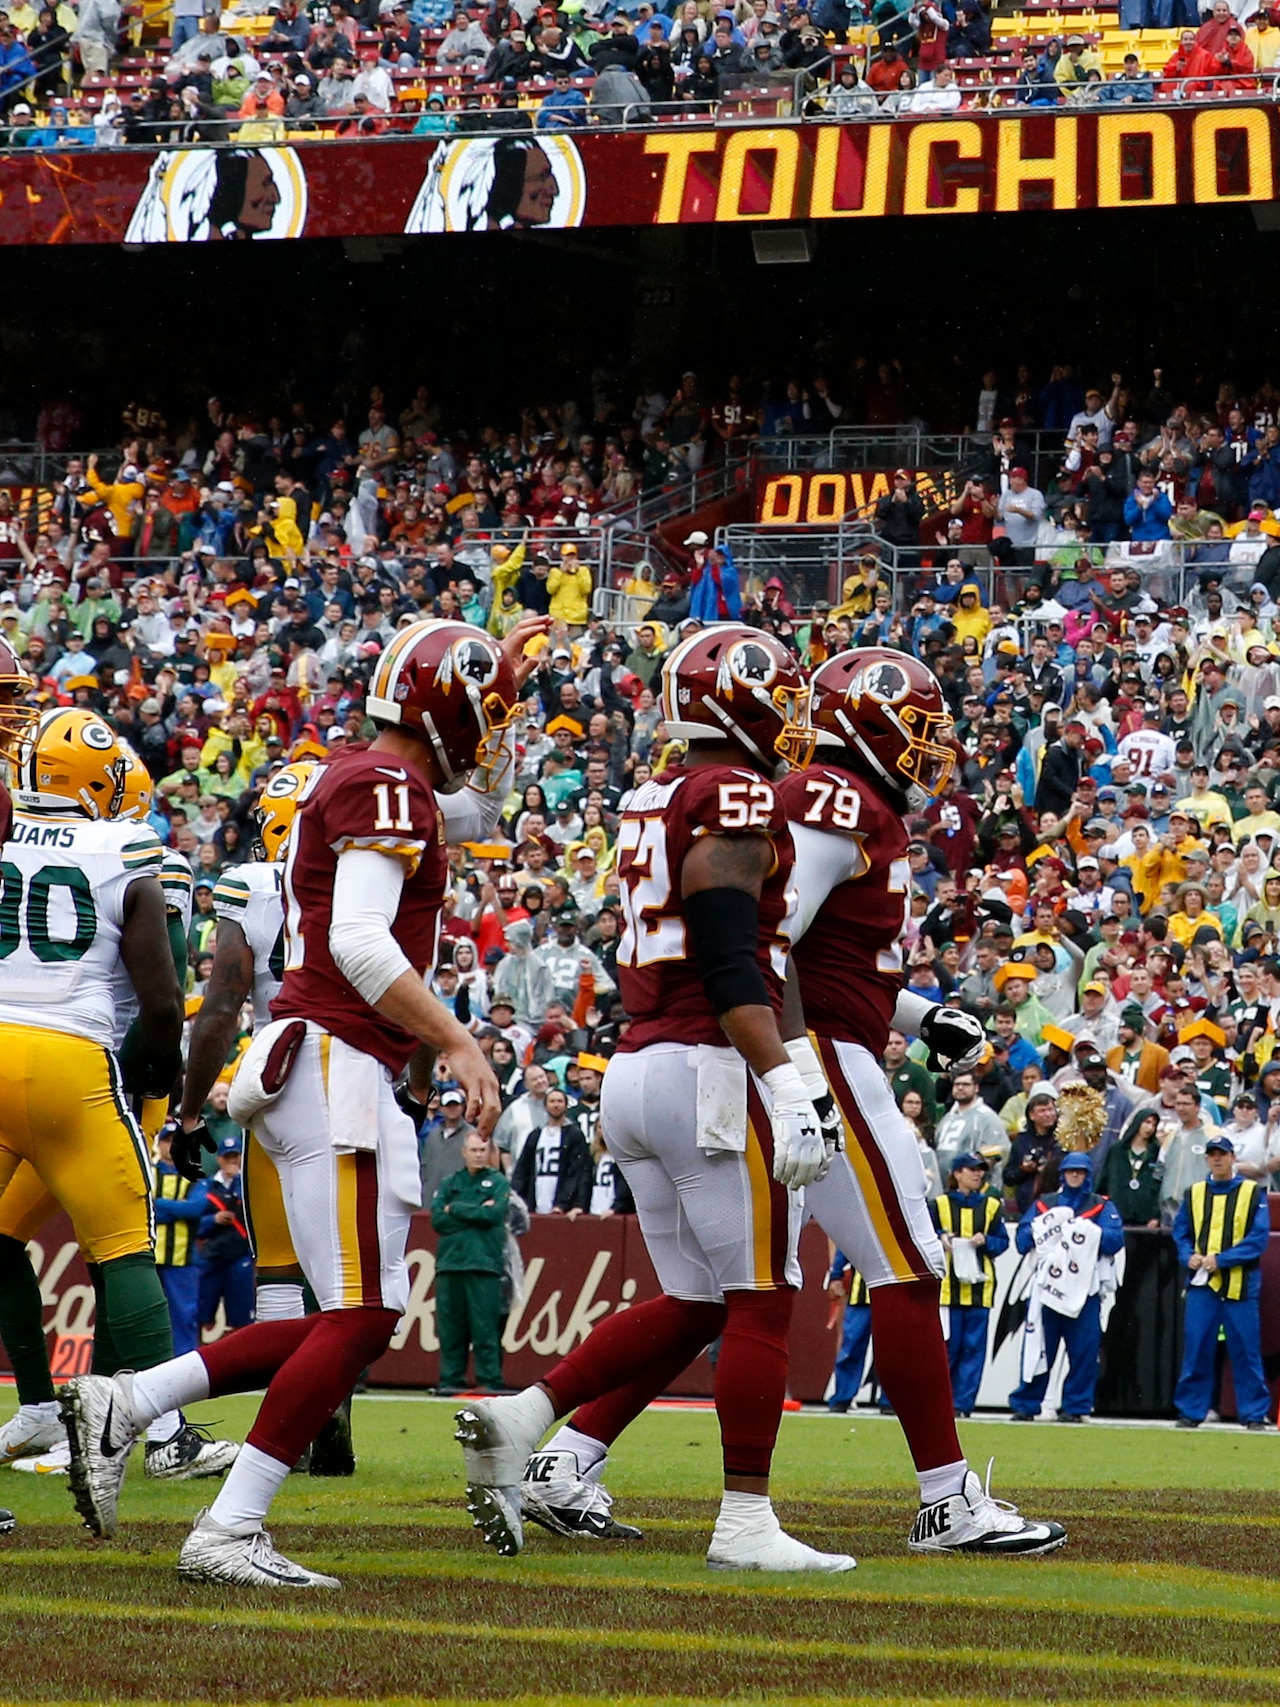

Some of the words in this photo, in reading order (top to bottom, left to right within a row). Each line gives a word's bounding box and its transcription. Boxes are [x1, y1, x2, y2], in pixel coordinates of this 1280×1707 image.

[373, 783, 413, 831] 11
[718, 783, 775, 828] 52
[803, 780, 861, 829] 79
[615, 815, 687, 968] 52
